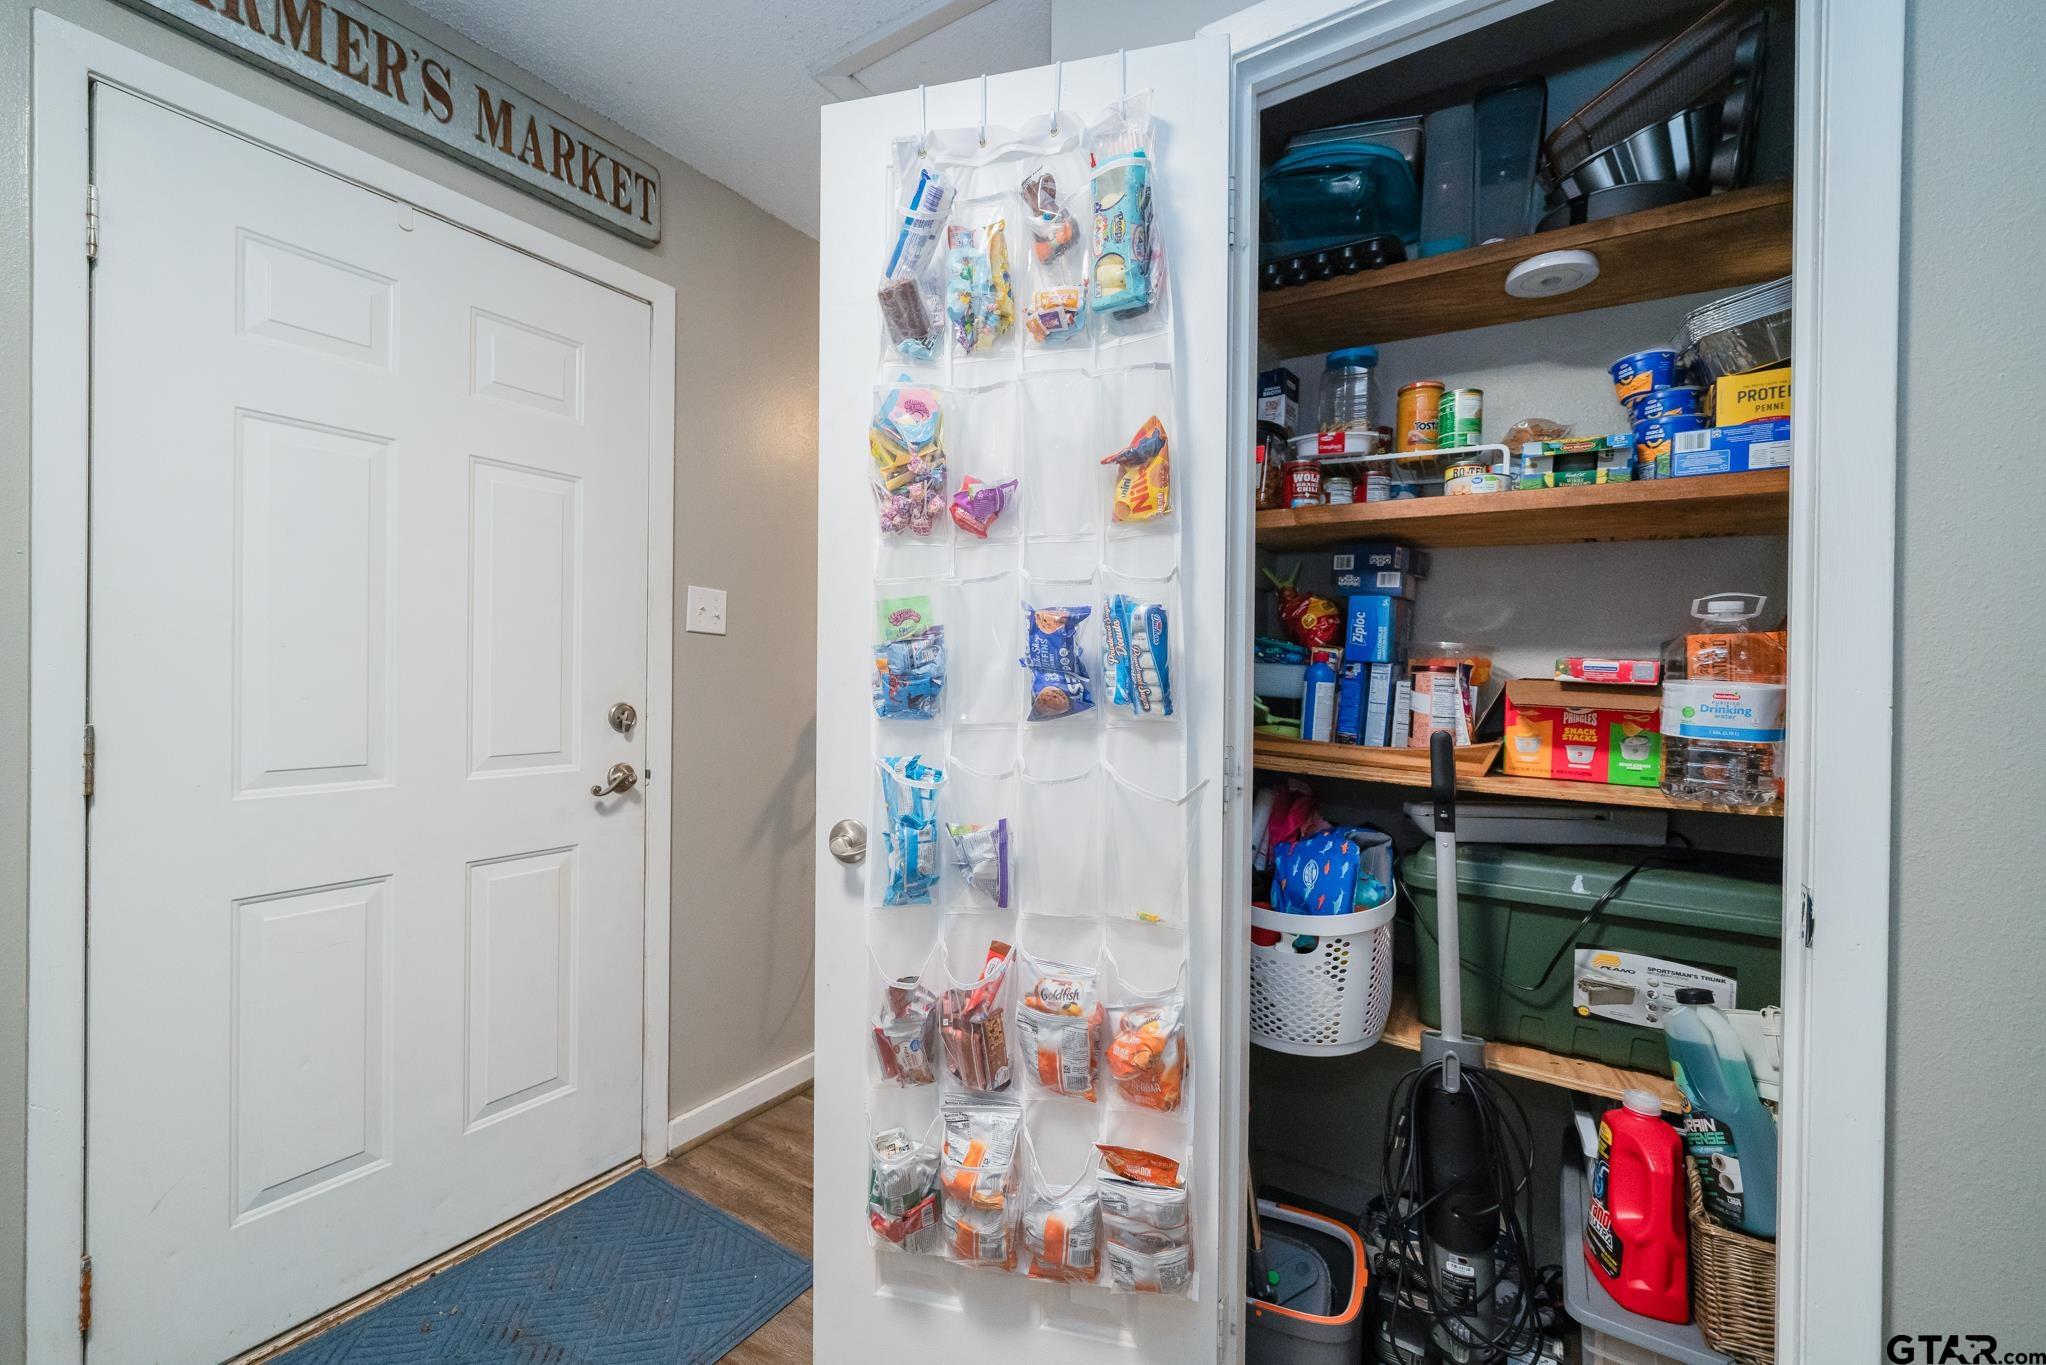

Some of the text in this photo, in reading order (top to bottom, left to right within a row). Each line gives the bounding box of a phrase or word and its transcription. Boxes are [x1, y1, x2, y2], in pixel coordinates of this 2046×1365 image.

[191, 0, 657, 226] MER'S MARKET
[1737, 385, 1792, 403] PROTEI
[1755, 402, 1785, 412] PENNE
[1415, 421, 1438, 431] TOST
[1352, 611, 1368, 643] Ziploc
[1041, 638, 1049, 668] UFFINS
[1700, 704, 1753, 718] Drinking
[1563, 711, 1597, 726] PRINGLES
[1562, 734, 1598, 742] STACKS
[1564, 727, 1597, 735] SNACK
[1600, 965, 1636, 975] PLANO
[1647, 966, 1699, 980] SPORTSMAN'S
[1700, 976, 1727, 984] TRUNK
[1040, 987, 1080, 1001] Goldfish
[1685, 1118, 1717, 1132] RAIN
